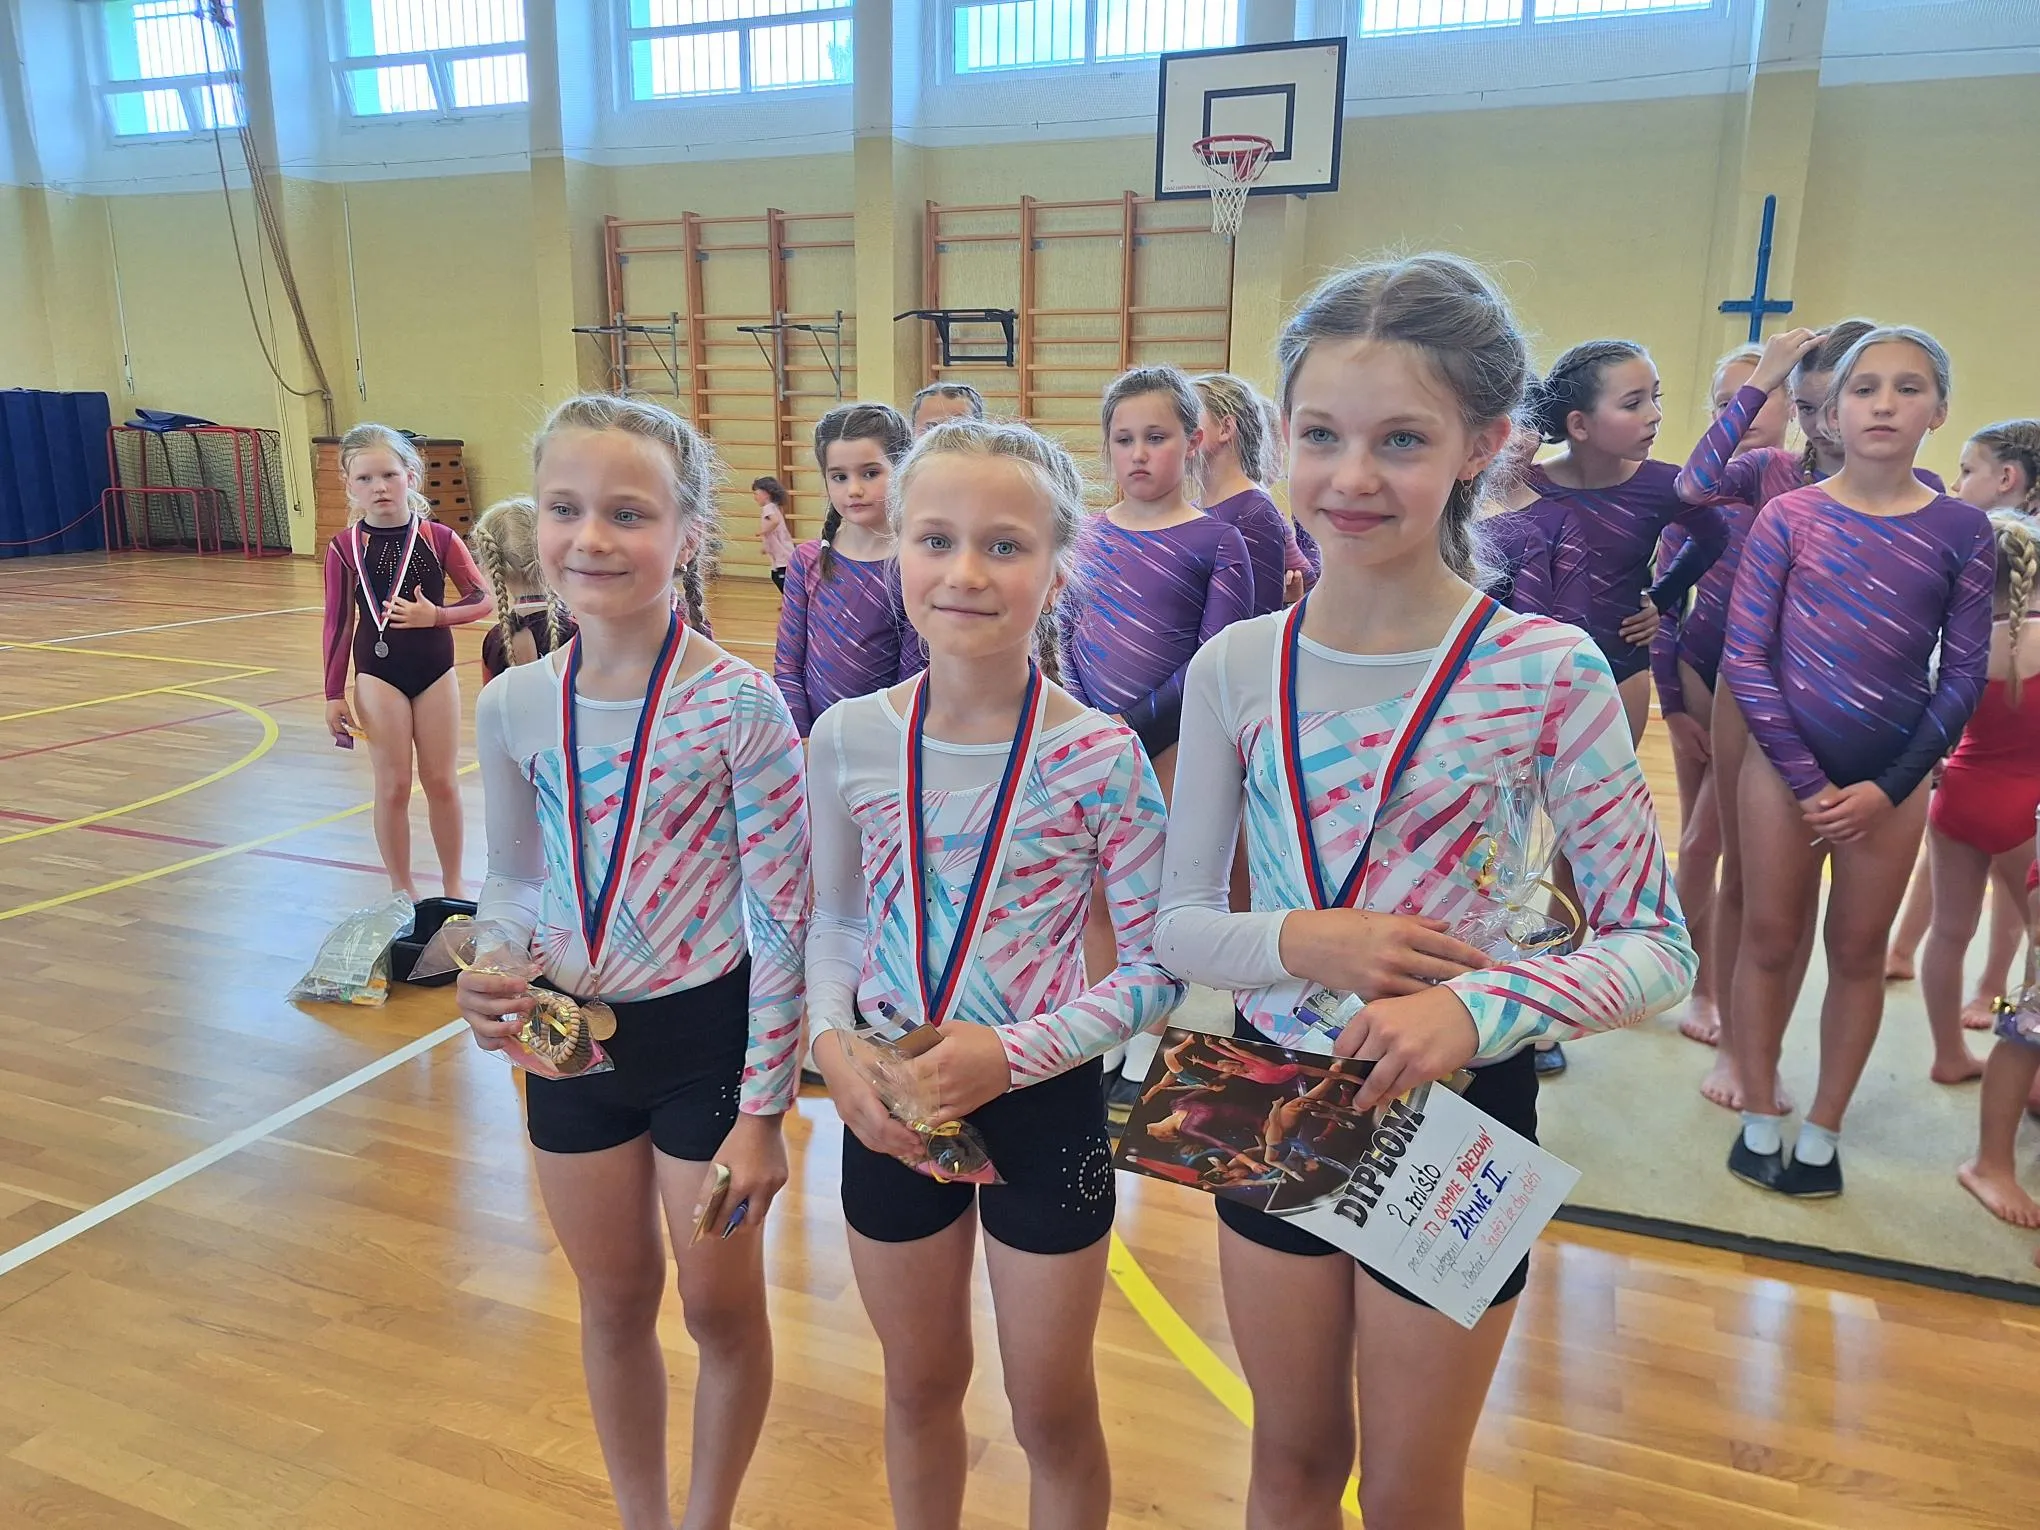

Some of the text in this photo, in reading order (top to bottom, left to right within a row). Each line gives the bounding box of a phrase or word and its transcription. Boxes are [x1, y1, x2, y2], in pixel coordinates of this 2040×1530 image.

[1333, 1096, 1426, 1228] DIPLOM
[1480, 1159, 1512, 1193] II.
[1386, 1163, 1440, 1227] 2. místo
[1435, 1177, 1465, 1220] OLYMPIE
